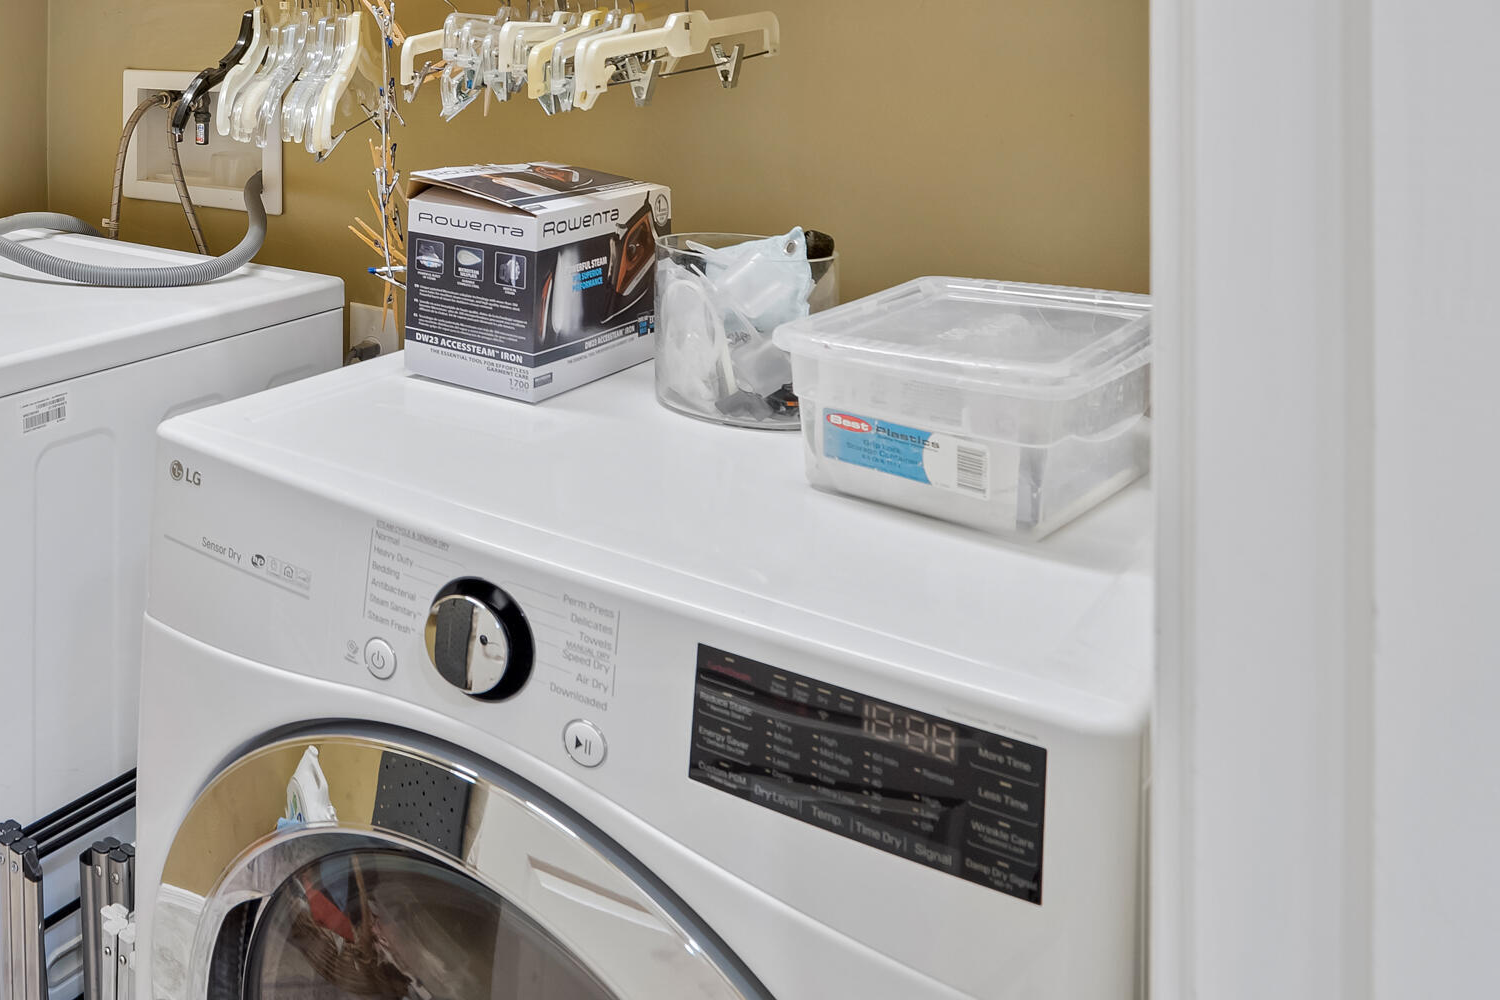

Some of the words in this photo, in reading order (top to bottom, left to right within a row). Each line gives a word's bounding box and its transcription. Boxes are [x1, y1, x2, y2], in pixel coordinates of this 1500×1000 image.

[415, 332, 439, 344] DW23
[500, 352, 523, 363] IRON
[509, 378, 529, 389] 1700
[830, 414, 869, 431] Best
[185, 467, 201, 486] LG
[202, 536, 227, 555] Sensor
[228, 548, 242, 563] Dry
[372, 560, 400, 580] Bedding
[570, 612, 613, 635] Delicates
[580, 631, 612, 651] Towels
[593, 660, 610, 674] Dry
[576, 673, 589, 685] Air
[592, 678, 608, 693] Dry
[549, 681, 608, 711] Downloaded
[856, 820, 881, 840] Time
[882, 831, 902, 849] Dry
[914, 843, 953, 866] Signal
